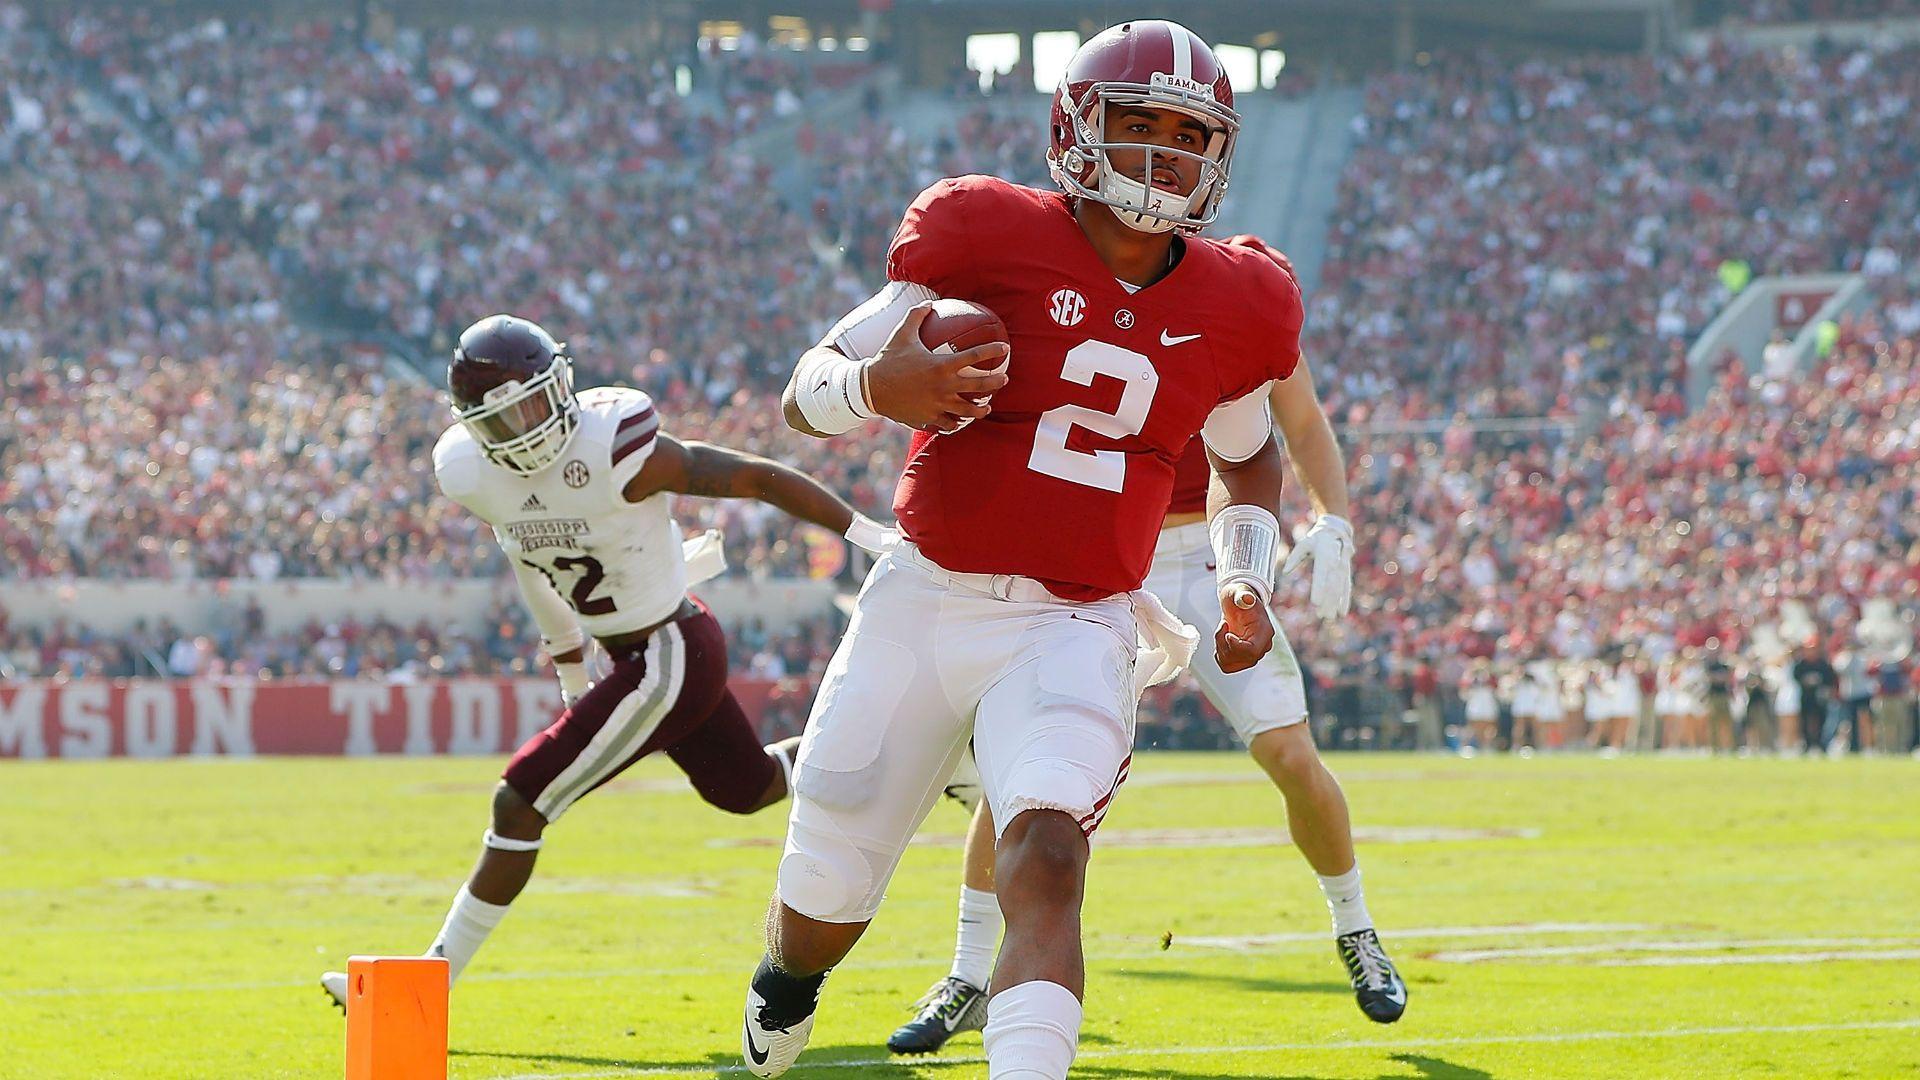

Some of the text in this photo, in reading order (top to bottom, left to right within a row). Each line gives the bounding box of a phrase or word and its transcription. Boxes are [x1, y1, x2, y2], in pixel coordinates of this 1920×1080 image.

[1167, 76, 1198, 91] BAMA
[1049, 289, 1087, 327] SEC
[1027, 338, 1160, 494] 2
[521, 555, 618, 616] 2
